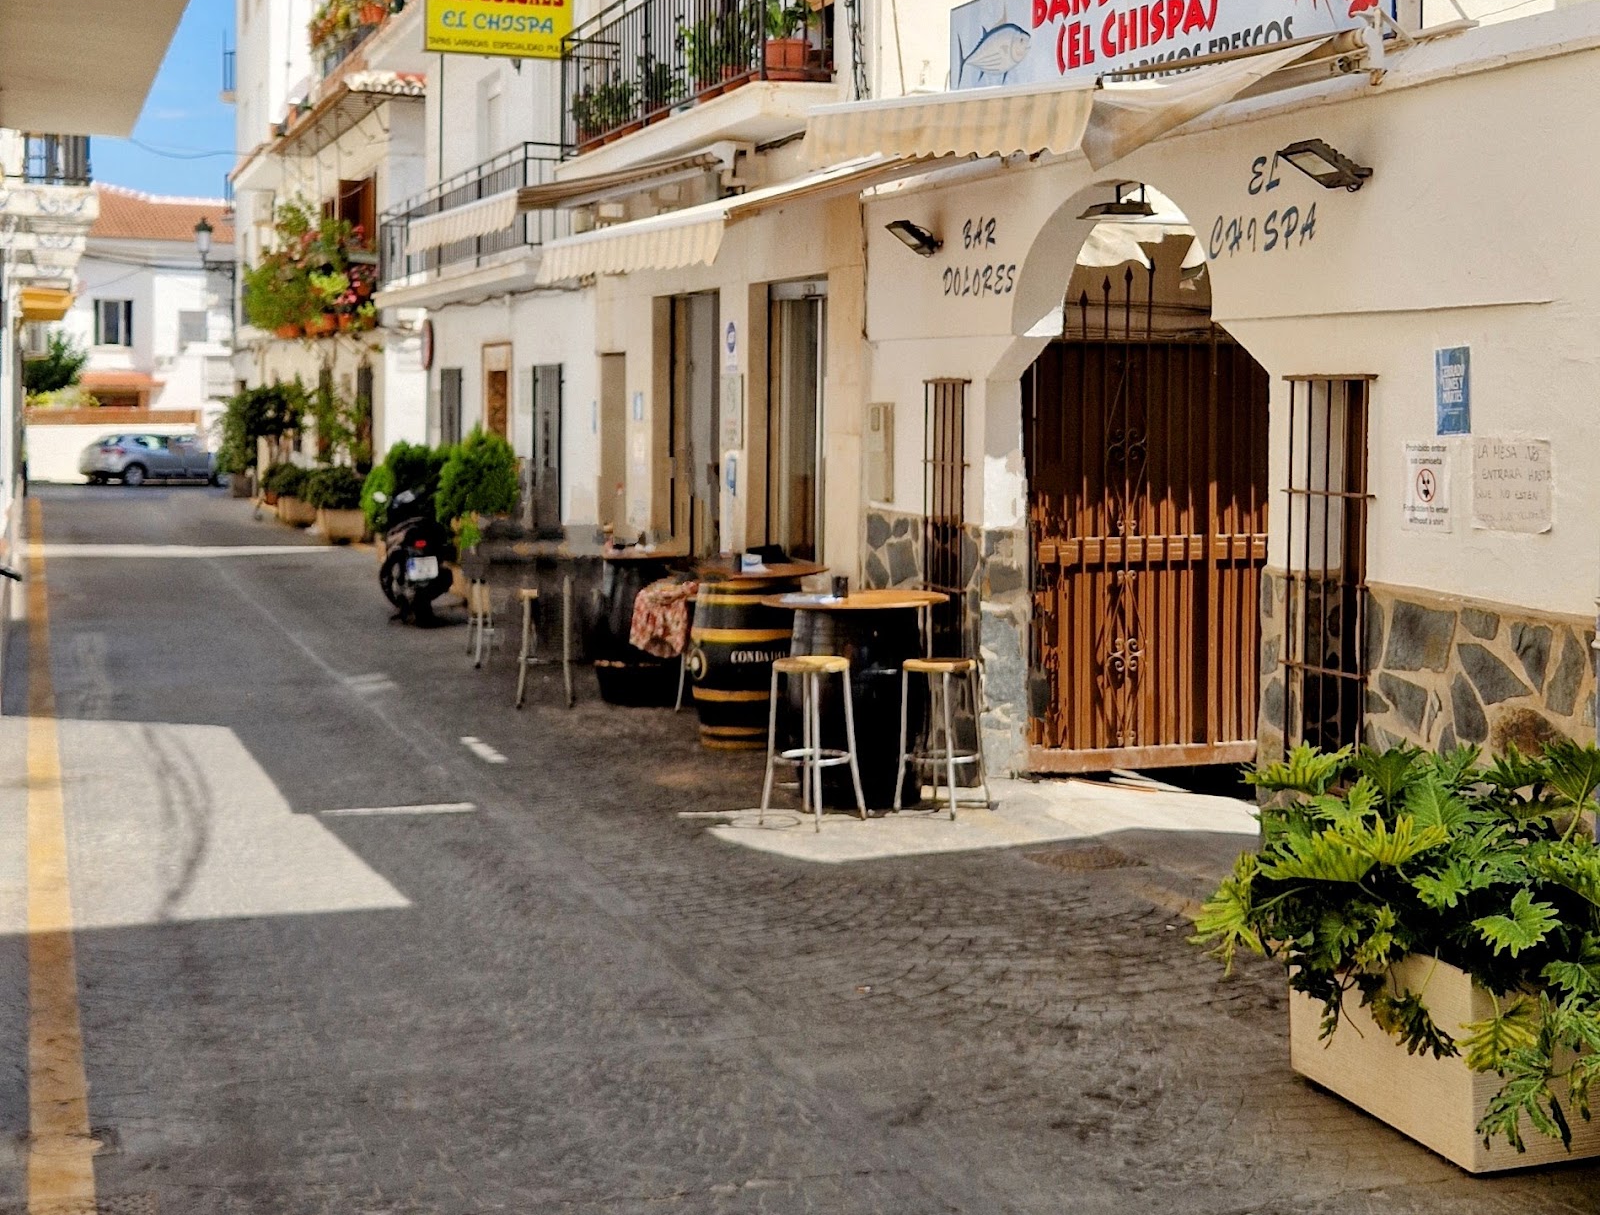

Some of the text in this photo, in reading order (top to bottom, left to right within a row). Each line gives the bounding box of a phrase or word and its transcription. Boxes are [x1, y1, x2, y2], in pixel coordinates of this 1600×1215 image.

[473, 13, 553, 35] CHISPA
[1055, 18, 1095, 75] (EL
[1247, 149, 1281, 197] EL
[962, 216, 997, 251] BAR
[1208, 201, 1318, 261] CHISPA
[942, 263, 1018, 299] DOLORES
[1418, 457, 1443, 465] camiseta
[1477, 444, 1489, 460] LA
[1493, 445, 1518, 460] MESA
[1435, 506, 1450, 514] enter
